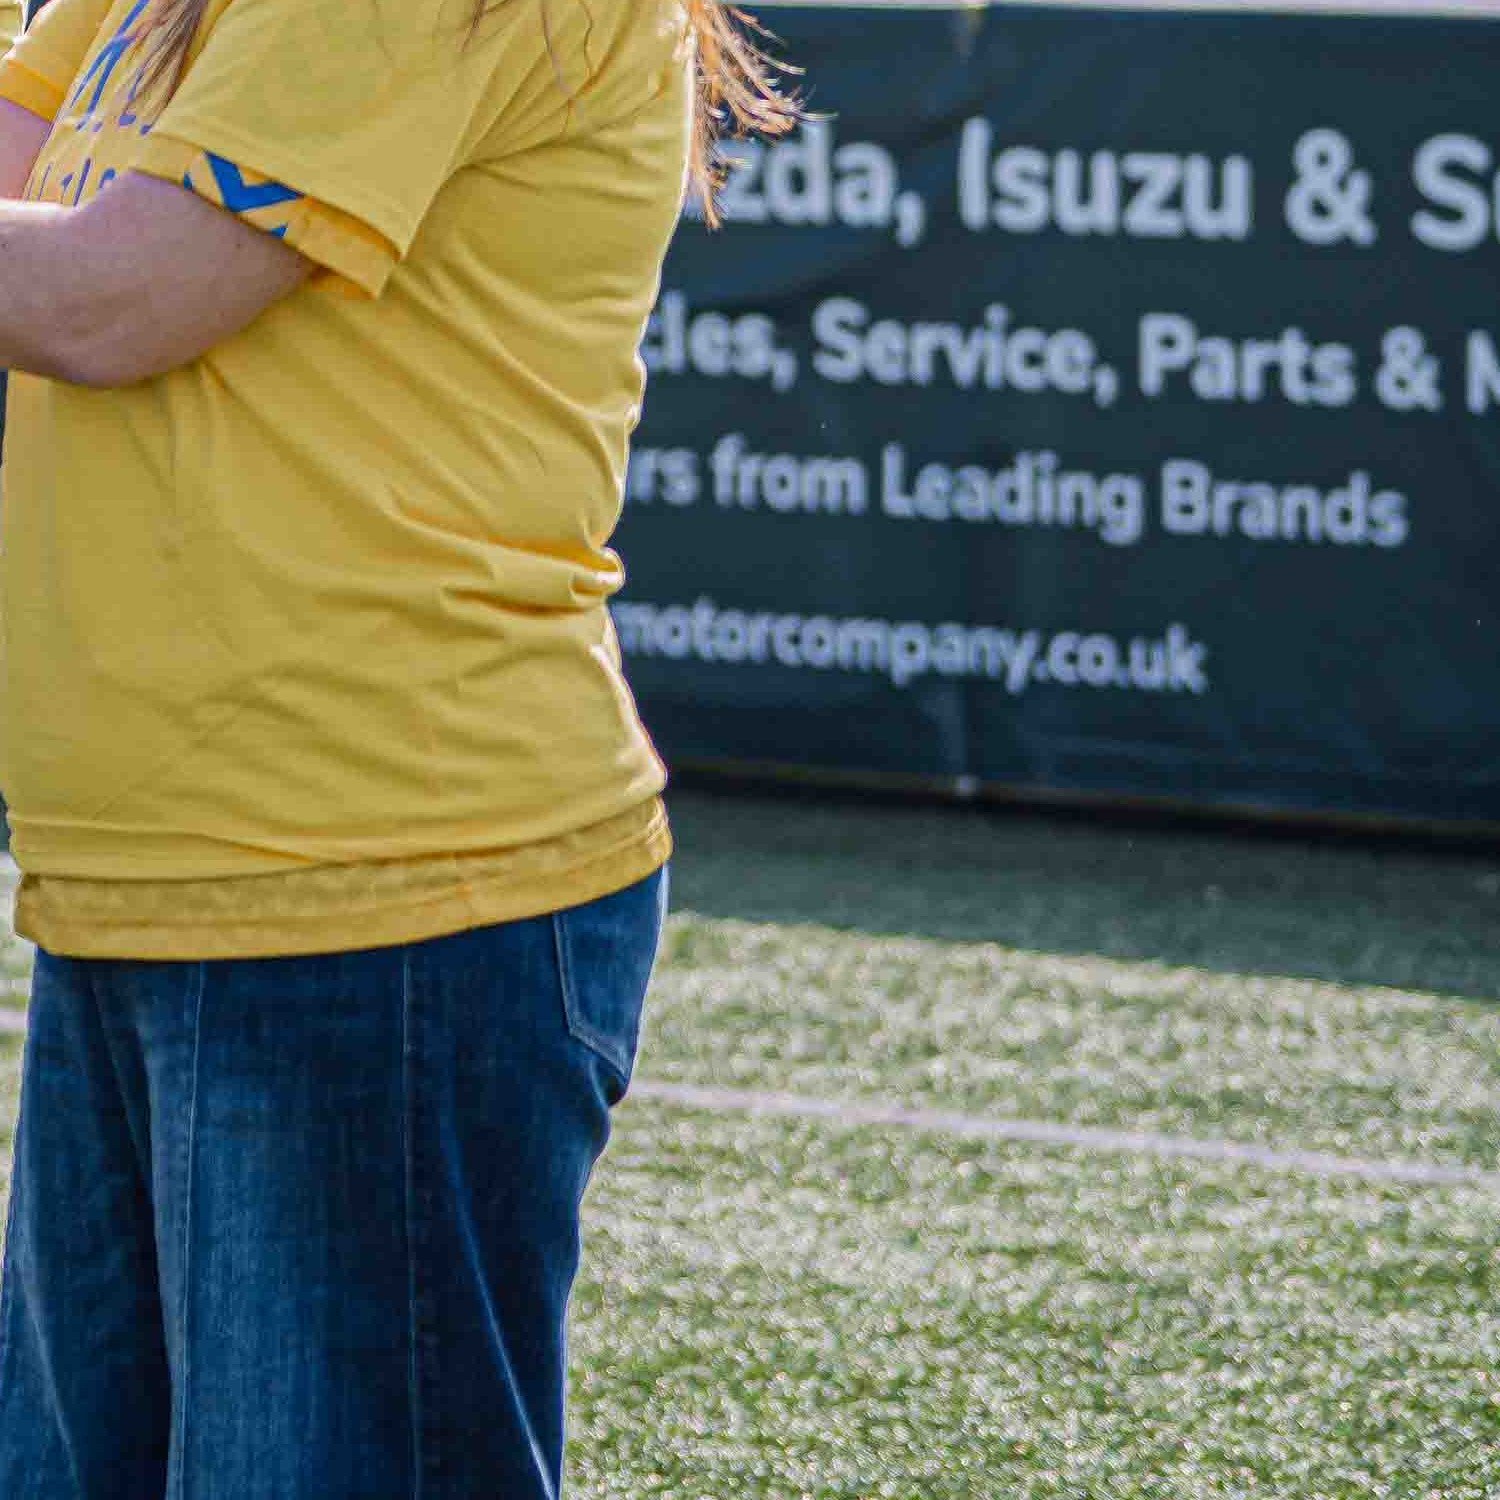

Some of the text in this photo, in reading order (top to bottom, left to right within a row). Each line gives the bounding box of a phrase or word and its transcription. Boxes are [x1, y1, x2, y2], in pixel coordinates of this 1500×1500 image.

[684, 116, 1500, 250] zda, Isuzu & S
[811, 297, 1119, 408] Service,
[1138, 313, 1356, 409] Parts
[1377, 325, 1443, 411] &
[710, 432, 868, 515] from
[881, 442, 1145, 544] Leading
[1161, 461, 1409, 547] Brands
